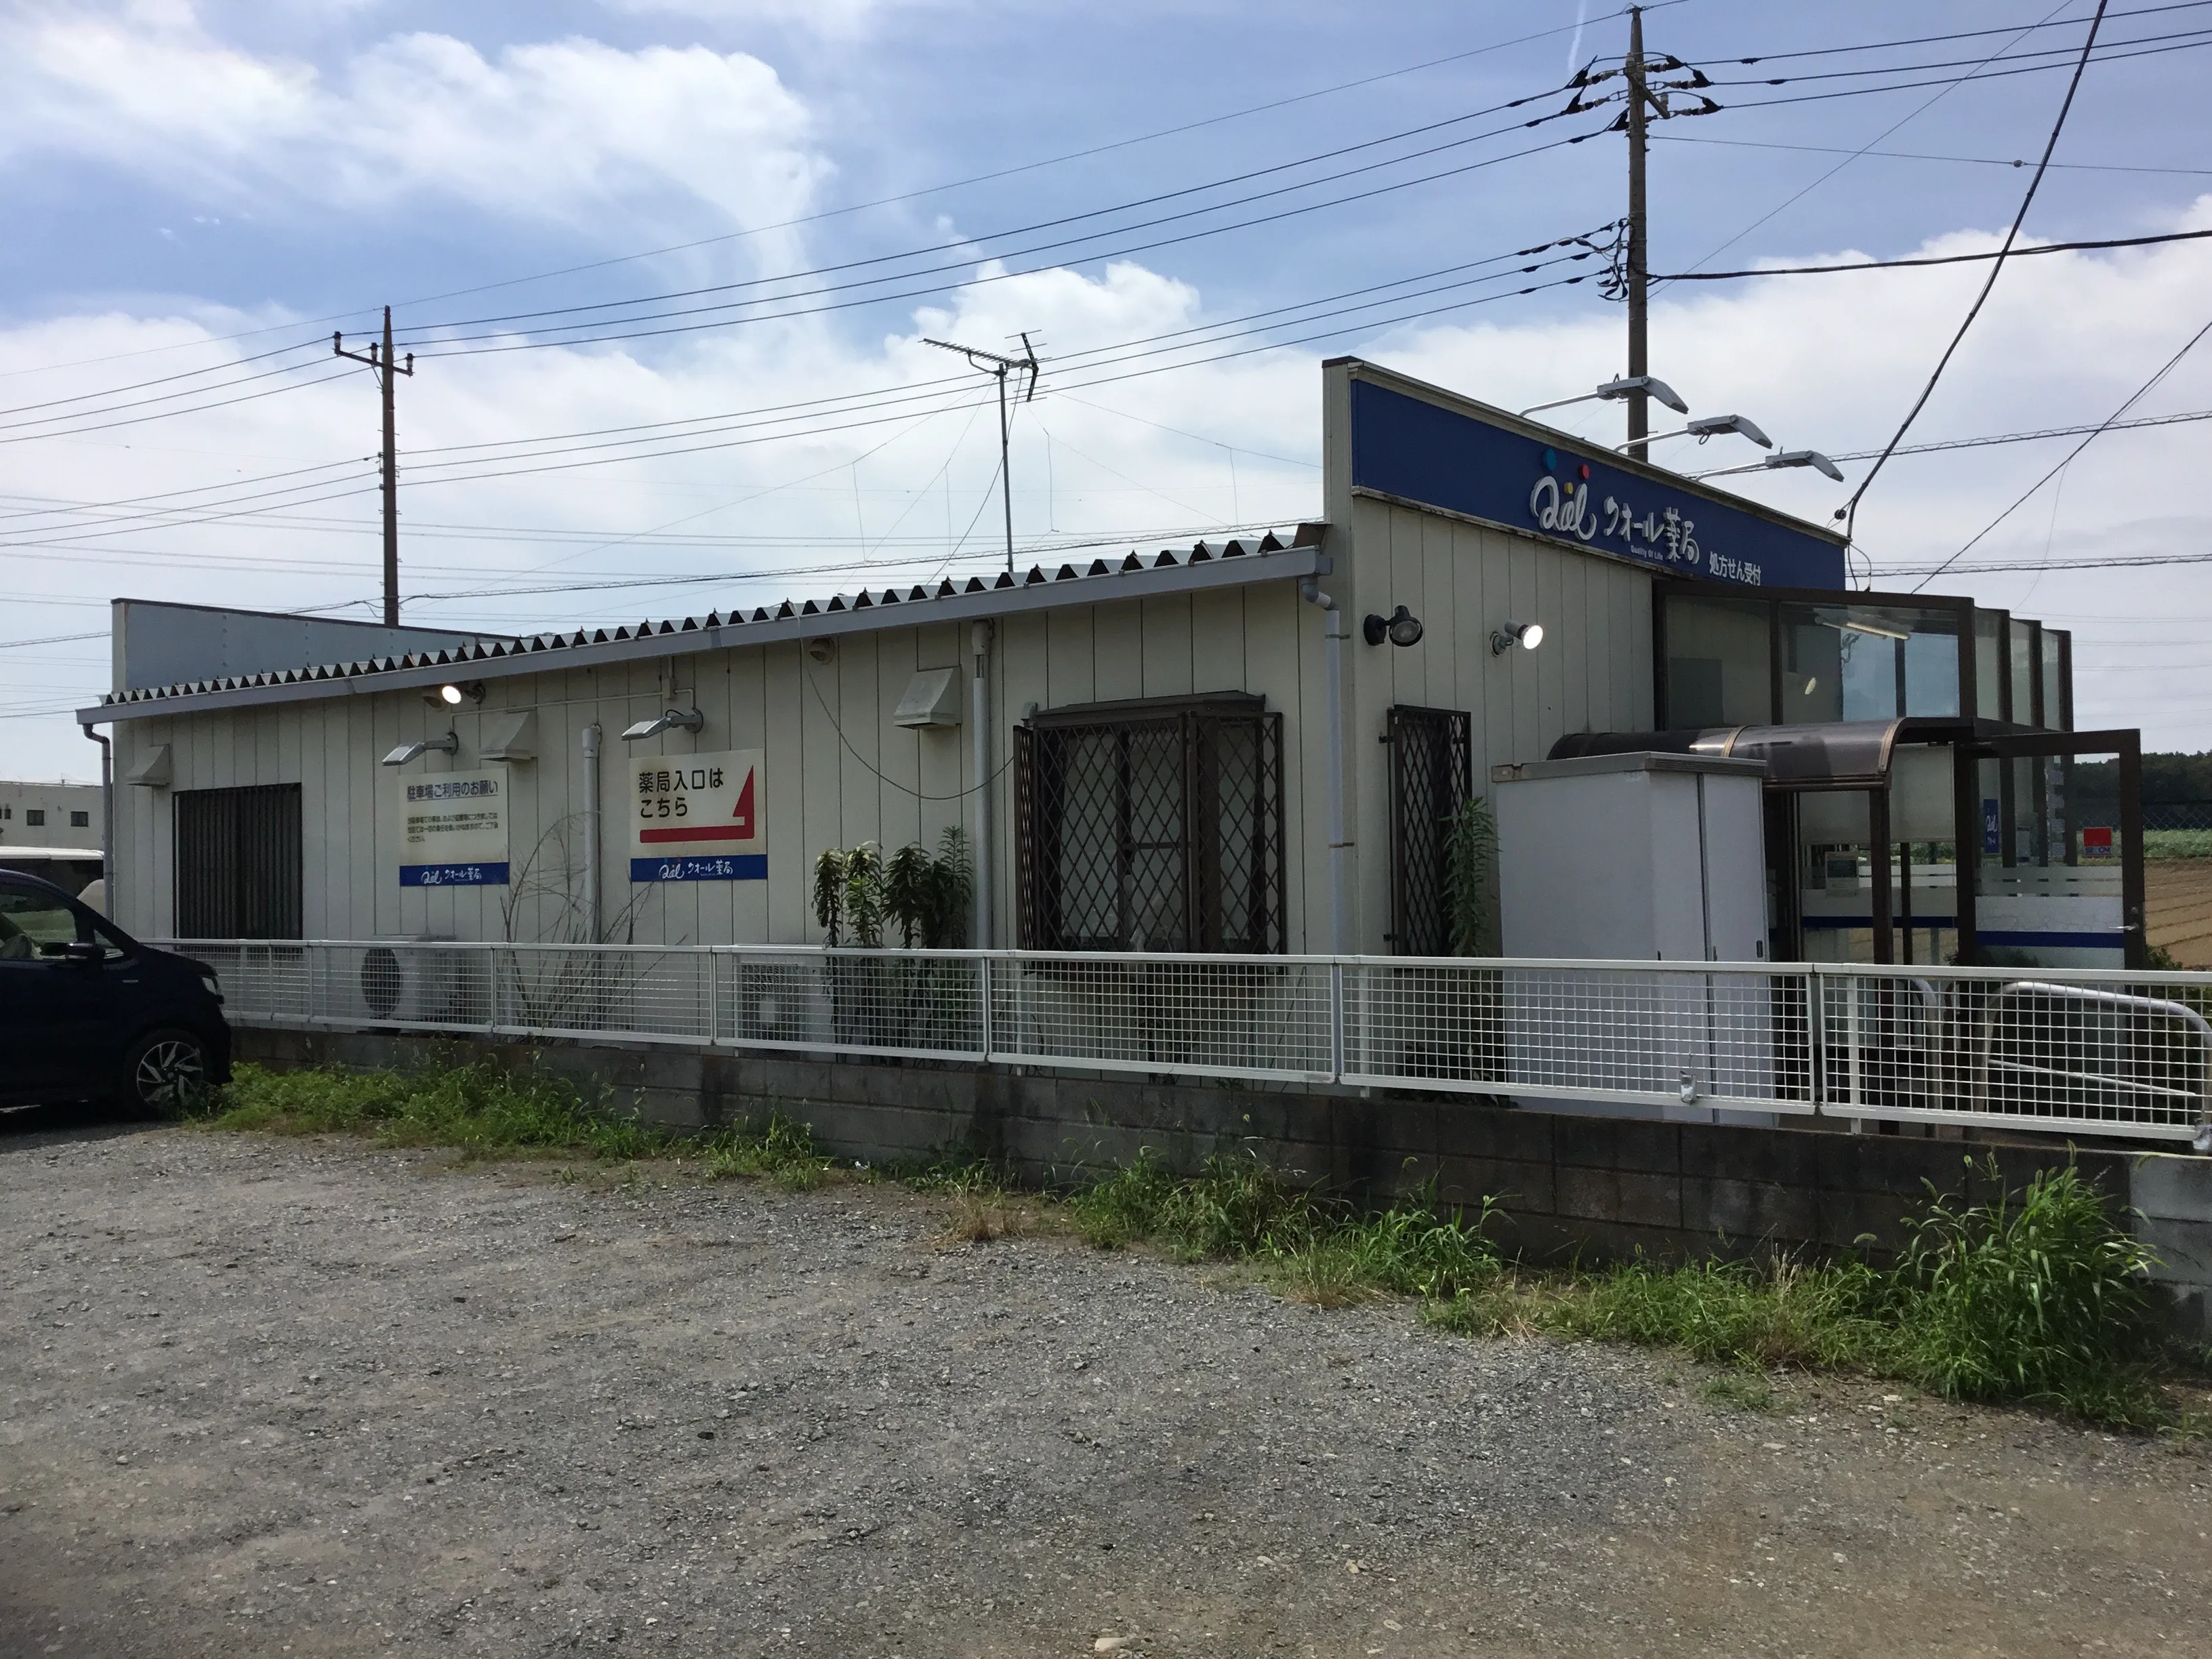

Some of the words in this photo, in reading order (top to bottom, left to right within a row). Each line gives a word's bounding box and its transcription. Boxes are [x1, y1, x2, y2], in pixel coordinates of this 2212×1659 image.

[1603, 495, 1700, 565] クオール薬局
[1709, 551, 1761, 586] 処方せん受付
[407, 780, 498, 800] 駐車場ご利用のお願い
[639, 768, 724, 794] 薬局入口は
[640, 797, 688, 818] こちら
[688, 859, 733, 876] クオール薬局
